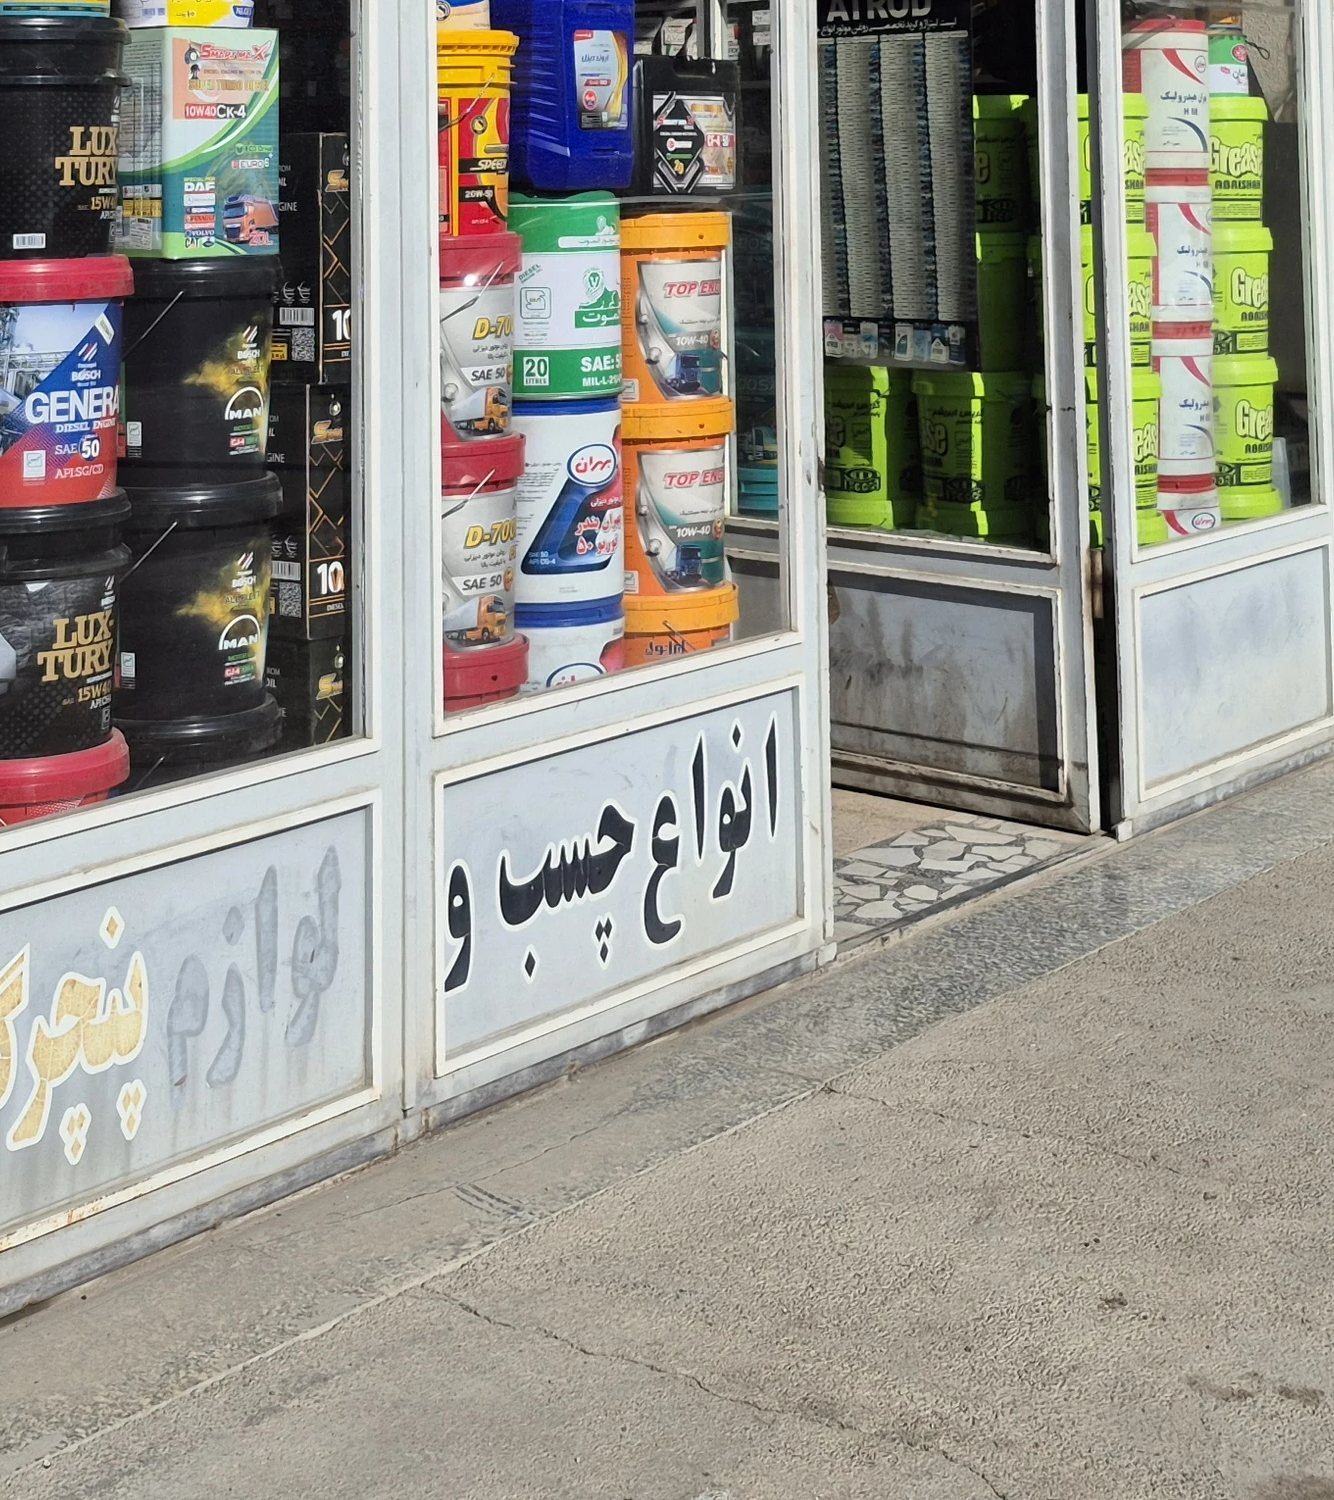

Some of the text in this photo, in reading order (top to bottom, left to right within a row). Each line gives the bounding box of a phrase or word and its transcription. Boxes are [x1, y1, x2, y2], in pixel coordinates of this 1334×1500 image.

[185, 104, 246, 118] 10W40 CK-4
[184, 182, 215, 191] DAF
[185, 237, 199, 248] CAT
[518, 264, 541, 281] DIESEL
[664, 282, 698, 297] TOP
[675, 334, 709, 346] 10W-40
[471, 368, 506, 382] SAE 50
[525, 358, 548, 377] 20
[25, 384, 119, 425] GENERA
[229, 407, 262, 419] MAN
[56, 423, 90, 433] DIESEL
[55, 438, 100, 458] SAE 50
[575, 456, 611, 474] بهران
[664, 472, 699, 489] TOP
[676, 524, 711, 537] 10W-40
[462, 574, 502, 591] SAE 50
[223, 634, 258, 650] MAN
[37, 639, 113, 683] TURY
[445, 711, 779, 995] انواع چسب و
[168, 846, 340, 1090] لوازم
